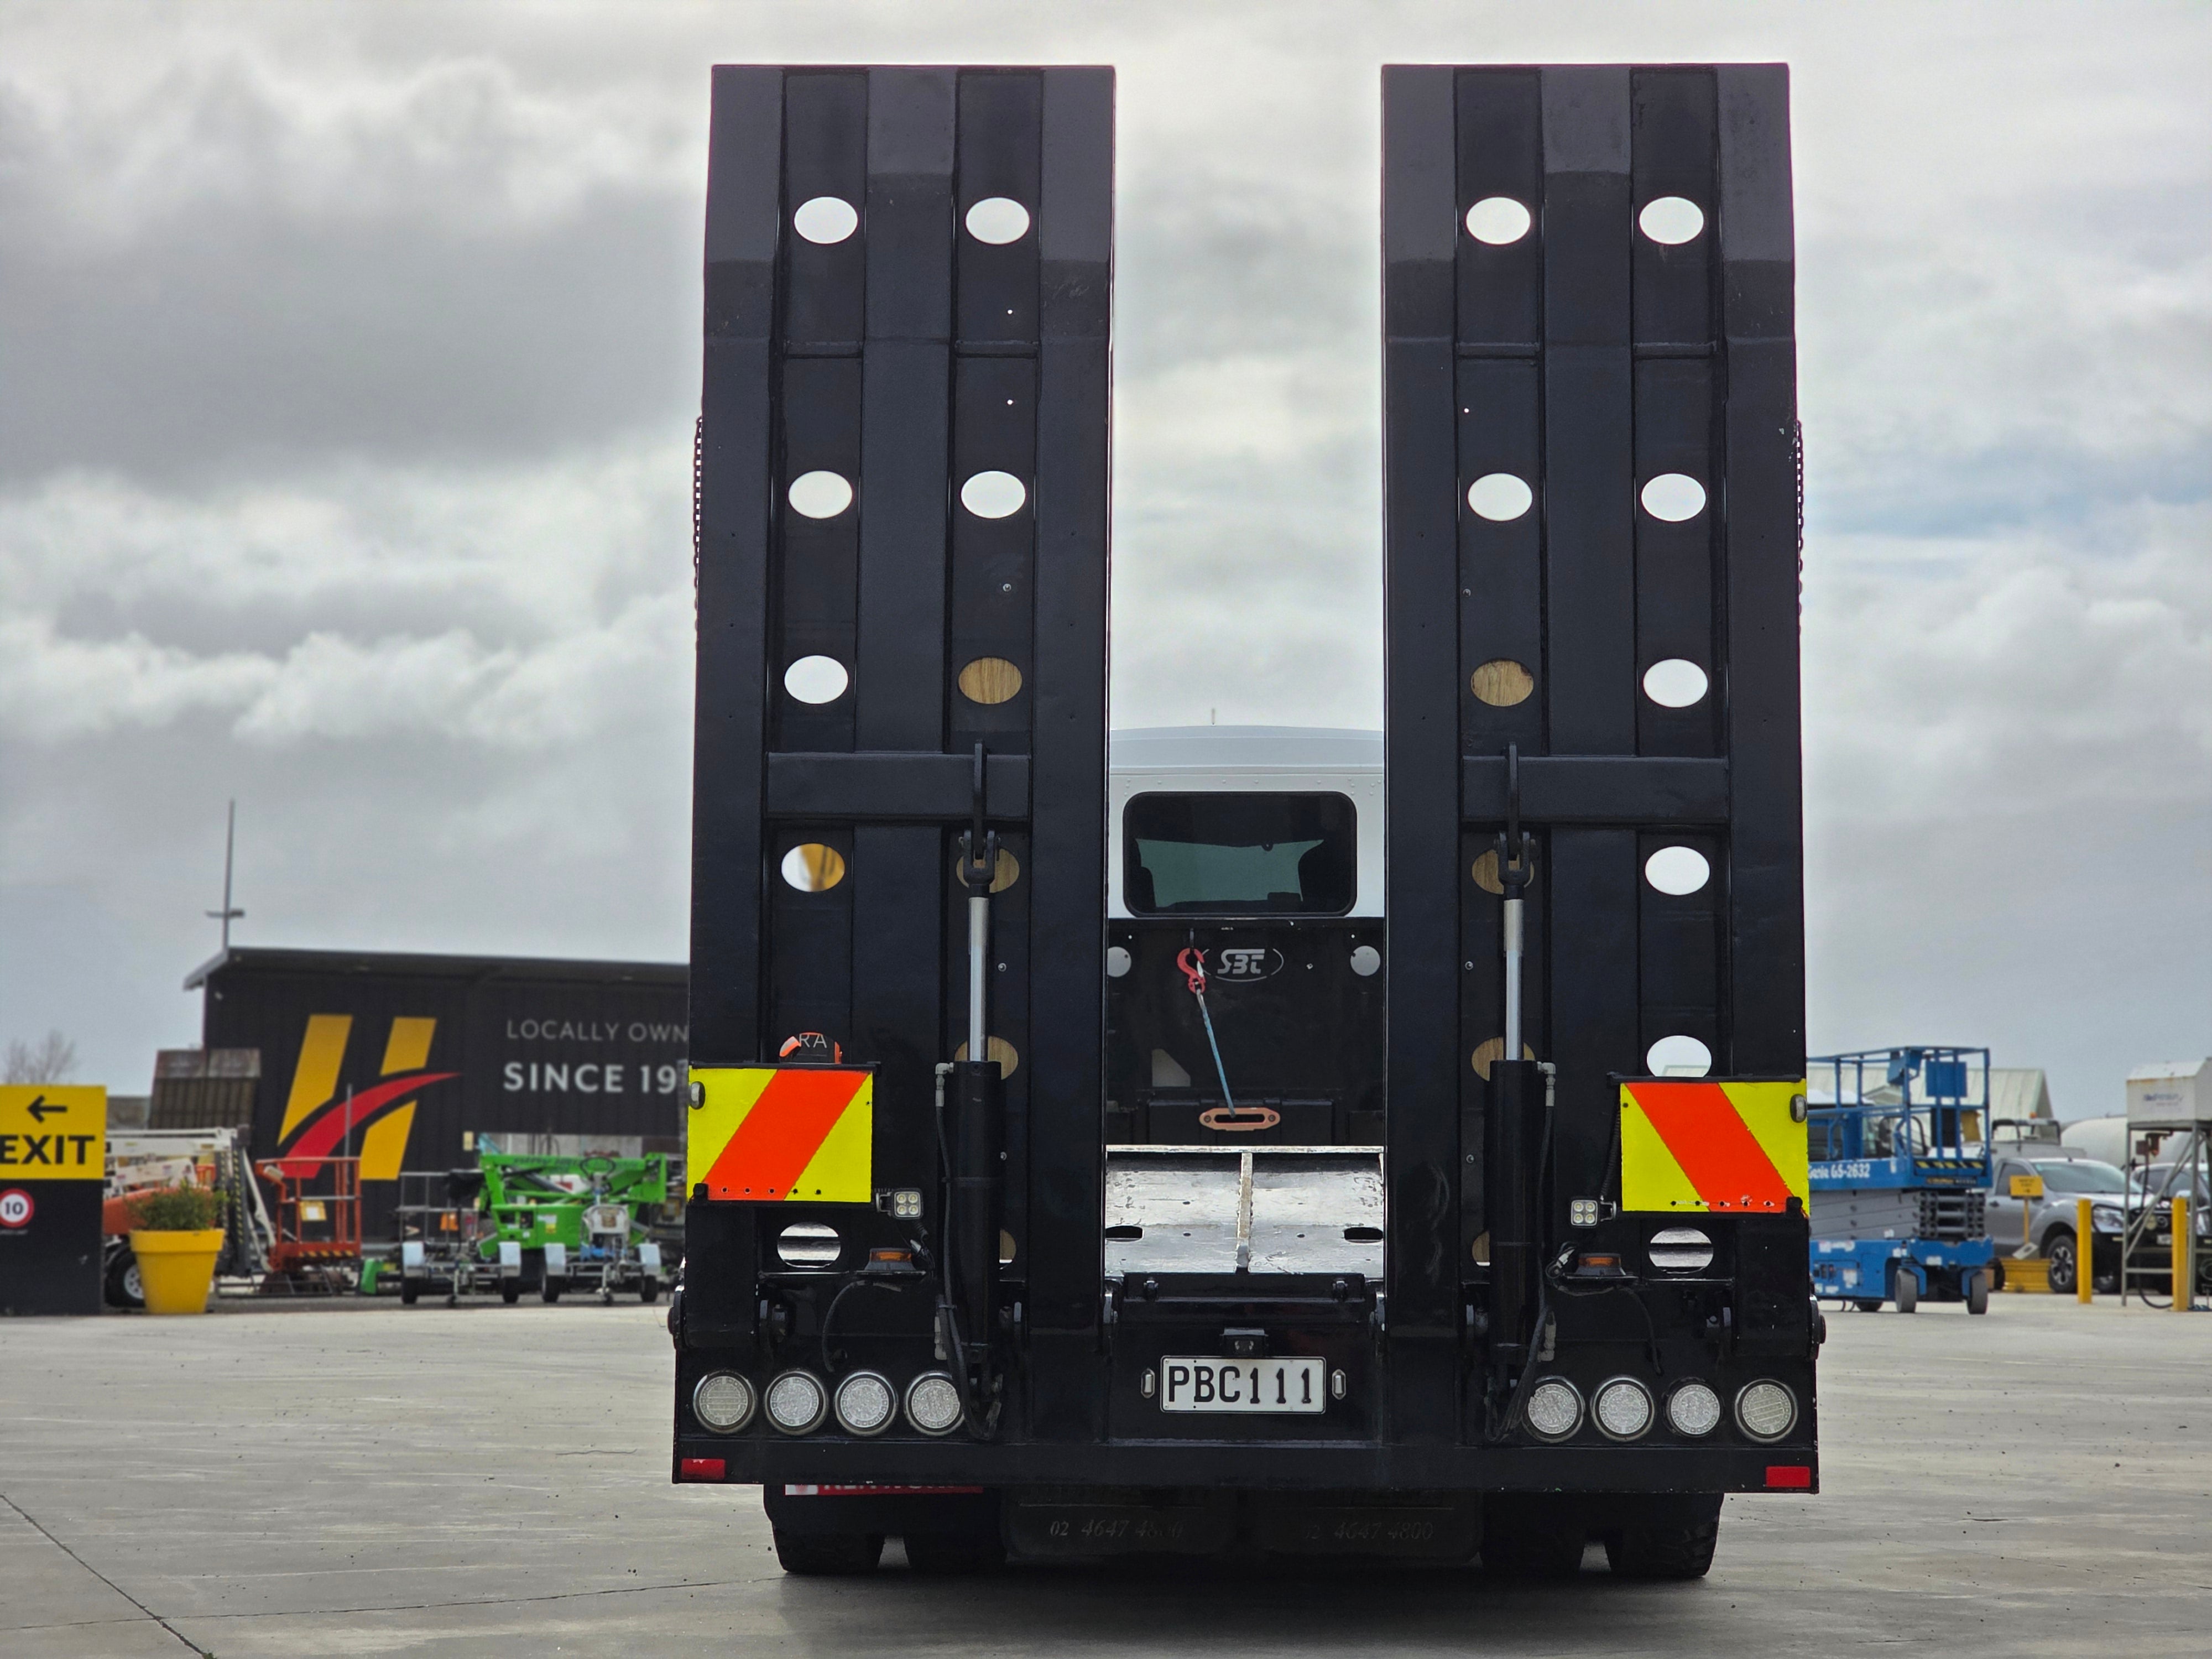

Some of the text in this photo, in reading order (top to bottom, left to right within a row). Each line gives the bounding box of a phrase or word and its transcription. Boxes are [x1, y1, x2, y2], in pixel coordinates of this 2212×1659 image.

[507, 1019, 688, 1042] LOCALLY OWN
[503, 1062, 677, 1094] SINCE 19
[0, 1135, 96, 1165] EXIT
[1830, 1163, 1870, 1178] GS-2632
[4, 1202, 24, 1215] 10
[1168, 1366, 1311, 1404] PBC111
[1049, 1520, 1069, 1537] 02
[1081, 1518, 1130, 1537] 4647
